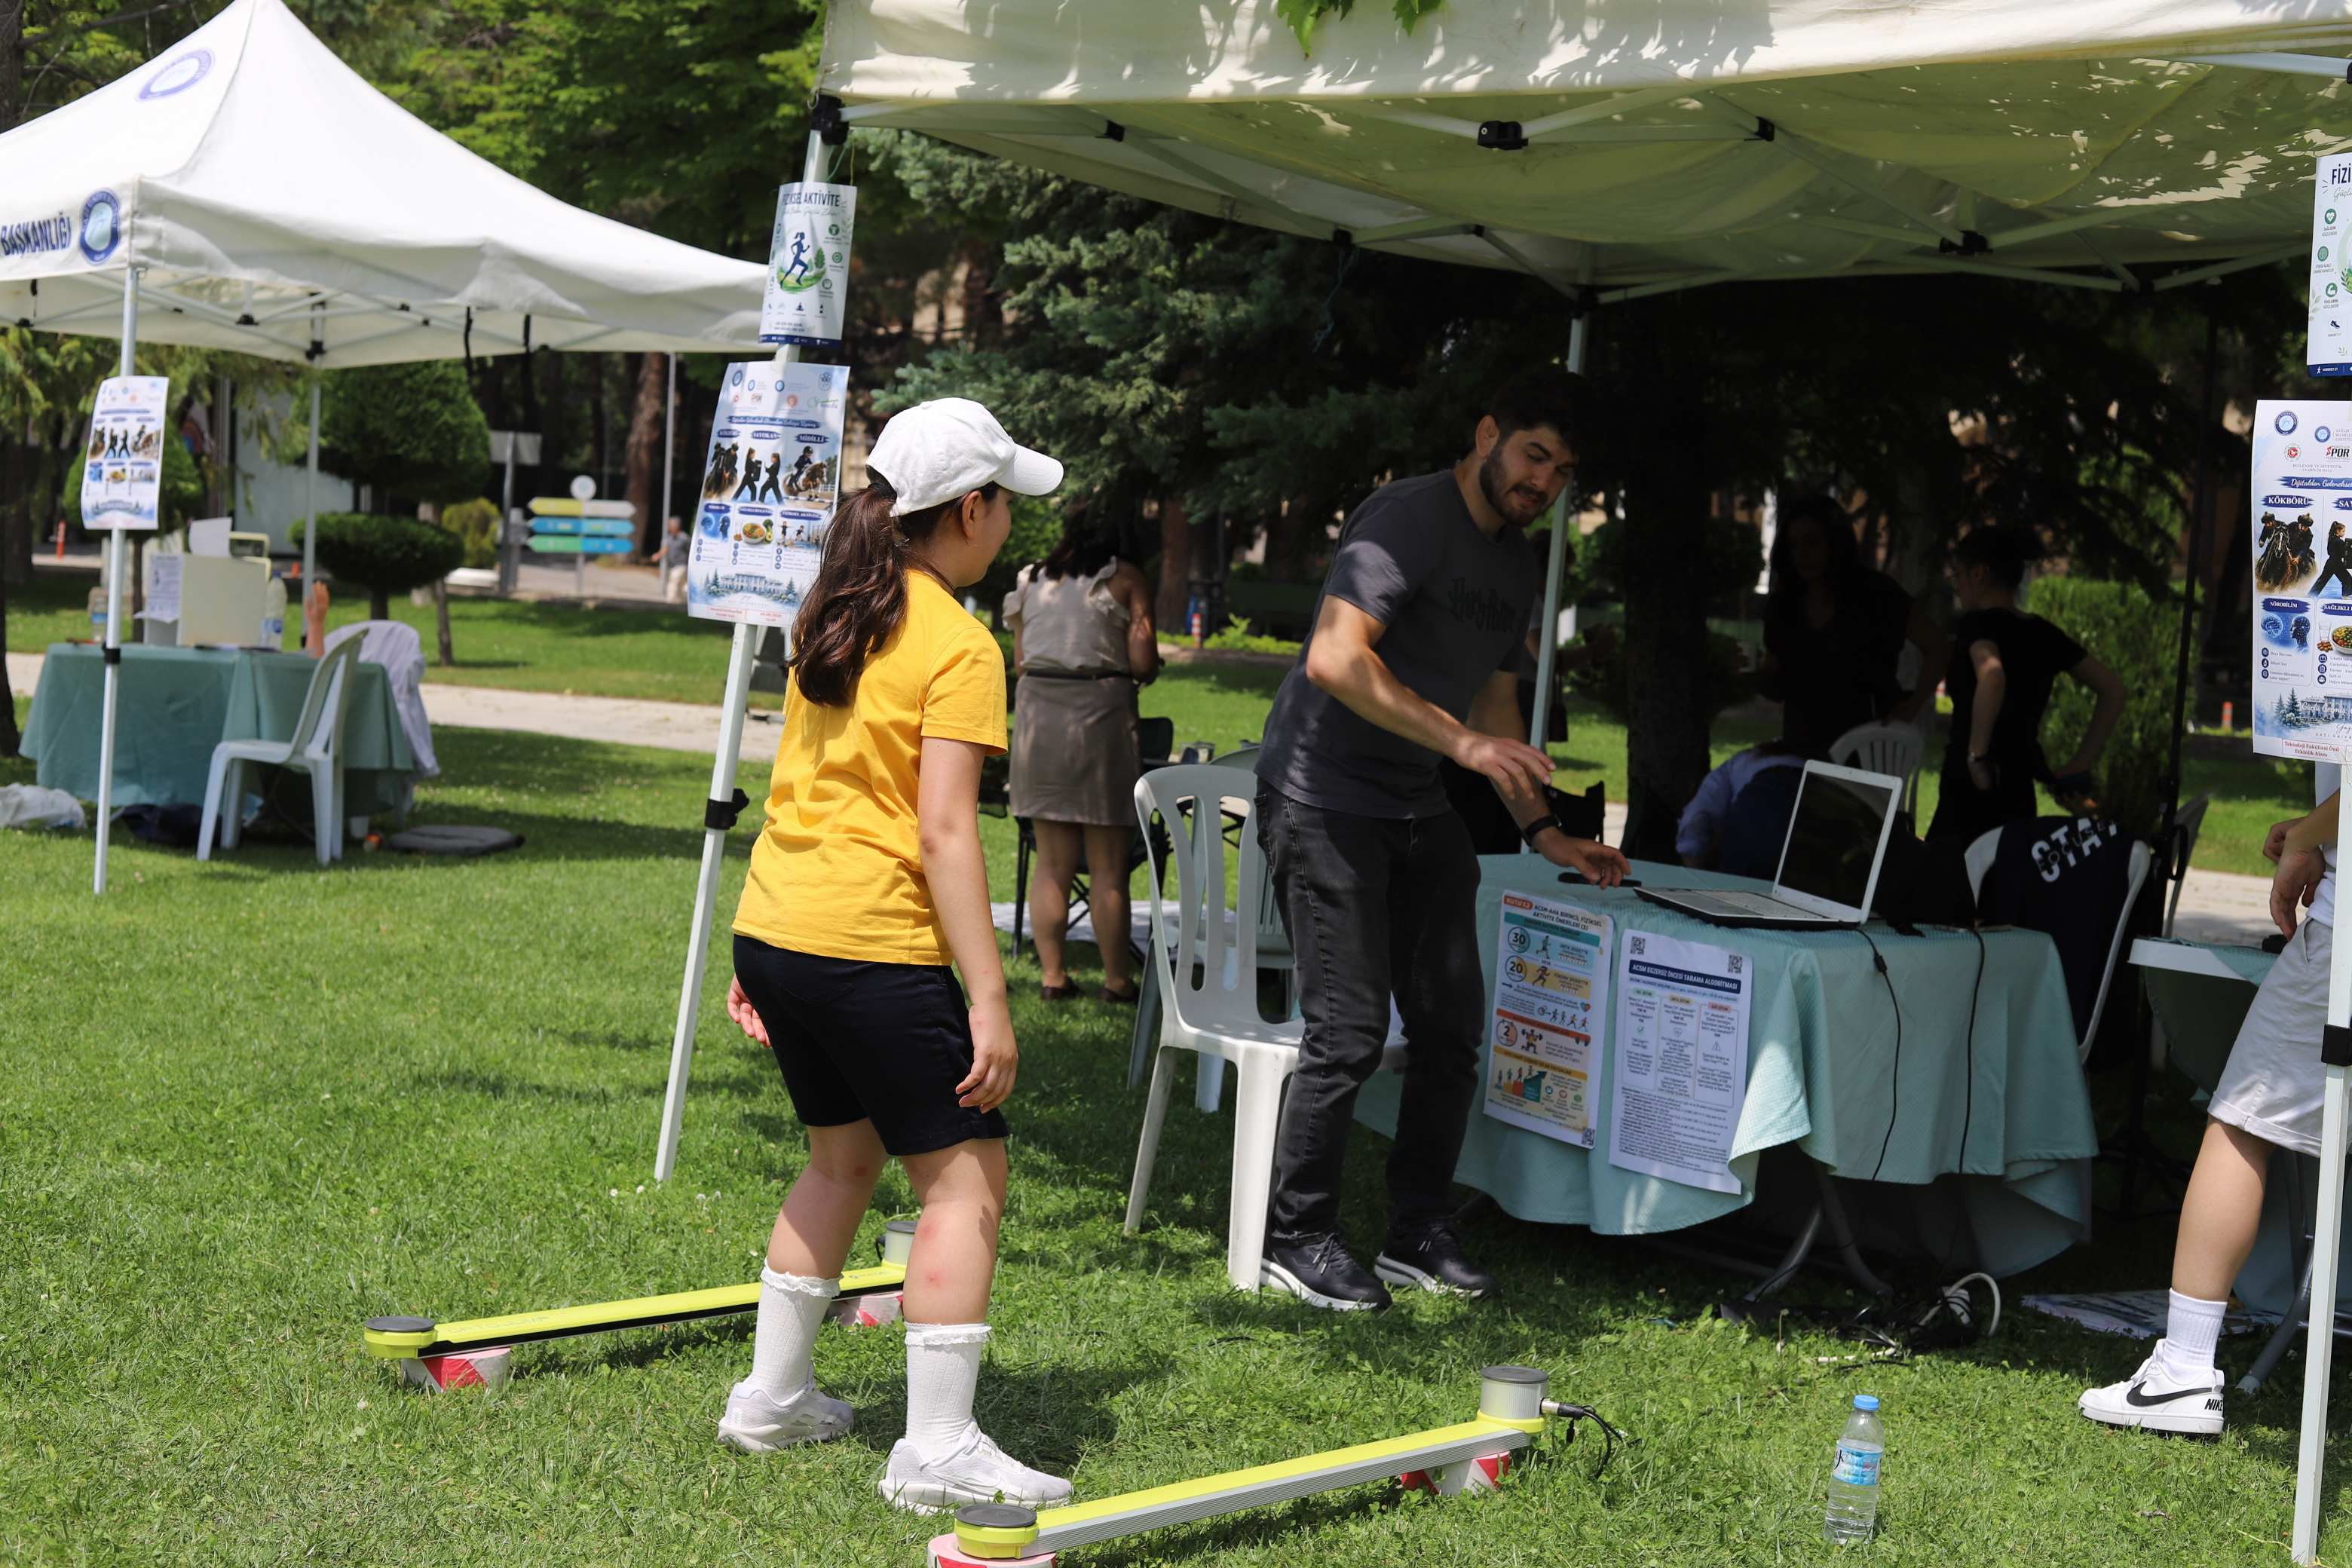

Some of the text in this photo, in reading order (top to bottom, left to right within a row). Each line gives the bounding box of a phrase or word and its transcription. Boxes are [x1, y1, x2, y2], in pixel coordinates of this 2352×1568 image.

[804, 190, 840, 207] AKTİVİTE
[1, 210, 72, 258] BAŞKANLIĞI
[2326, 446, 2350, 457] SPOR
[2291, 478, 2321, 488] Dijitalden
[2268, 496, 2309, 505] KÖKBÖRÜ
[1506, 896, 1522, 906] KUTU
[1533, 911, 1554, 922] AKTİVİTE
[1555, 916, 1580, 929] ÖNERİLERİ
[1534, 905, 1602, 927] ACSM-AHA BİRİNCİL FİZİKSEL
[1513, 933, 1526, 945] 30
[1509, 961, 1523, 974] 20
[1554, 972, 1568, 981] YÜKSEK
[1632, 964, 1738, 990] ACSM EGZERSİZ ÖNCESİ TARAMA ALGORİTMASI
[1503, 1026, 1510, 1037] 2
[448, 1315, 550, 1334] OPTOJUMP
[2204, 1398, 2223, 1411] NIKE
